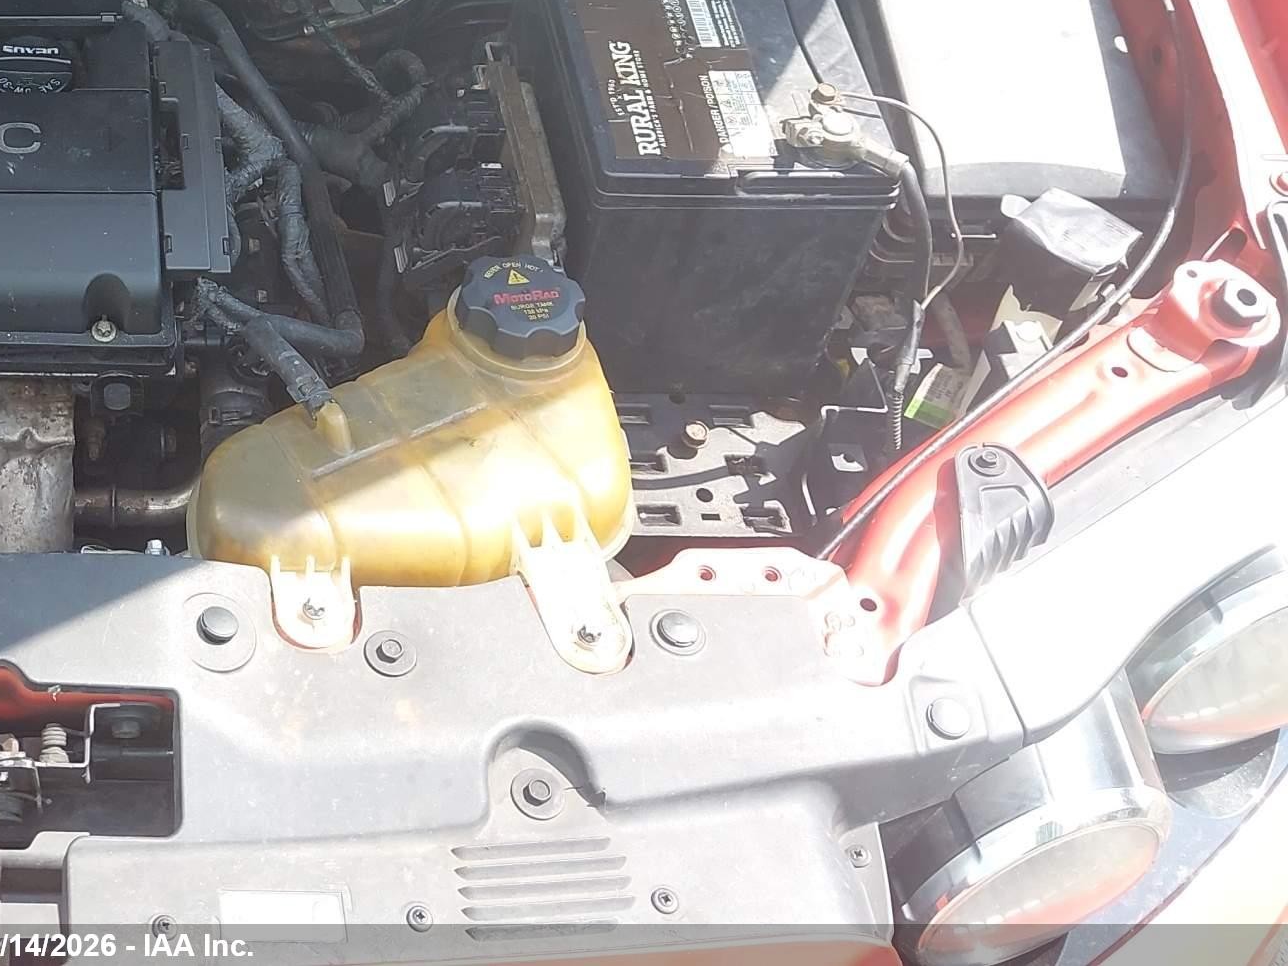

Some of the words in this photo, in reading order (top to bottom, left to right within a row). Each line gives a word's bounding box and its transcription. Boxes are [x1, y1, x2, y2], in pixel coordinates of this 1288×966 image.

[608, 41, 642, 86] KING
[632, 49, 644, 69] STORE
[638, 69, 650, 88] HOME
[646, 95, 657, 113] FARM
[623, 89, 662, 156] RURAL
[650, 114, 668, 148] AMERICA'S
[501, 261, 521, 269] OPEN
